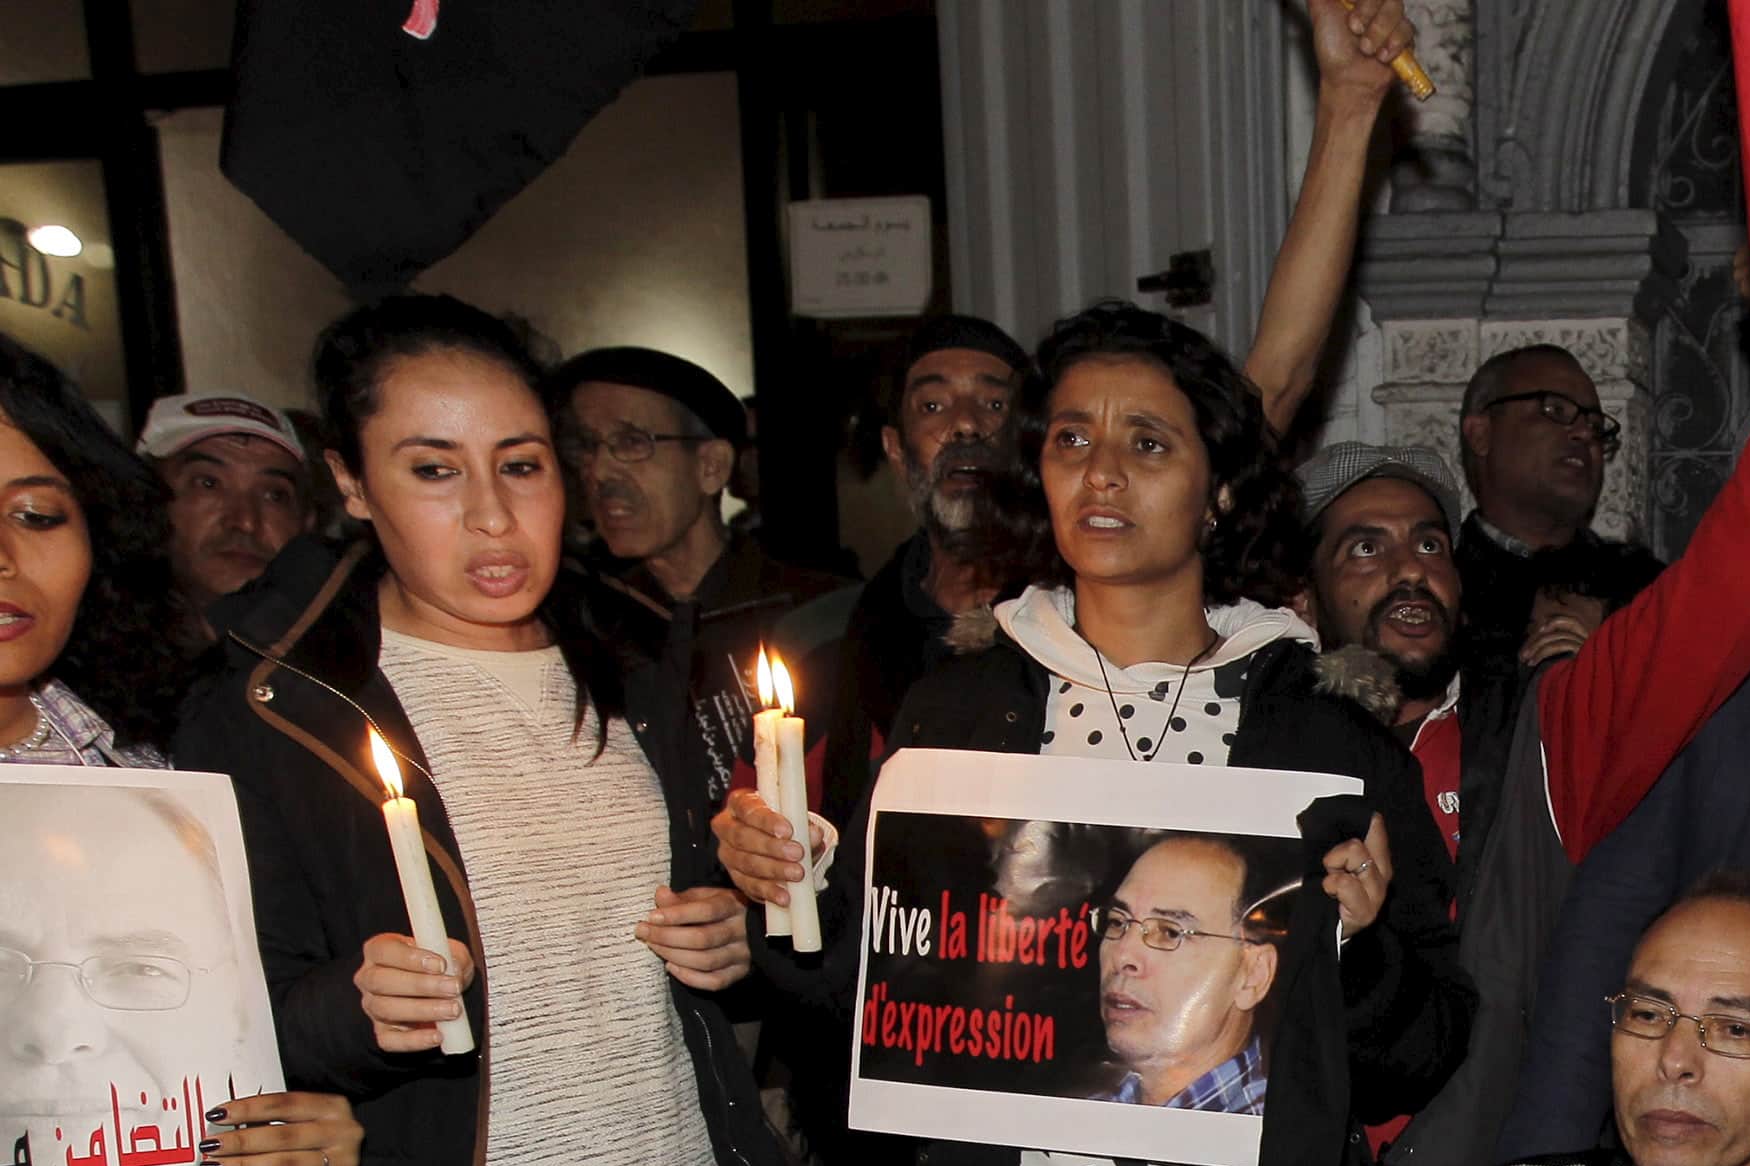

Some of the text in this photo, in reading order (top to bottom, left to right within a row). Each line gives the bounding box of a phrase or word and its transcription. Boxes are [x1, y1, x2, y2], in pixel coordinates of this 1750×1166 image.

[871, 886, 1090, 969] Vive la liberté
[862, 981, 1054, 1067] d'expression
